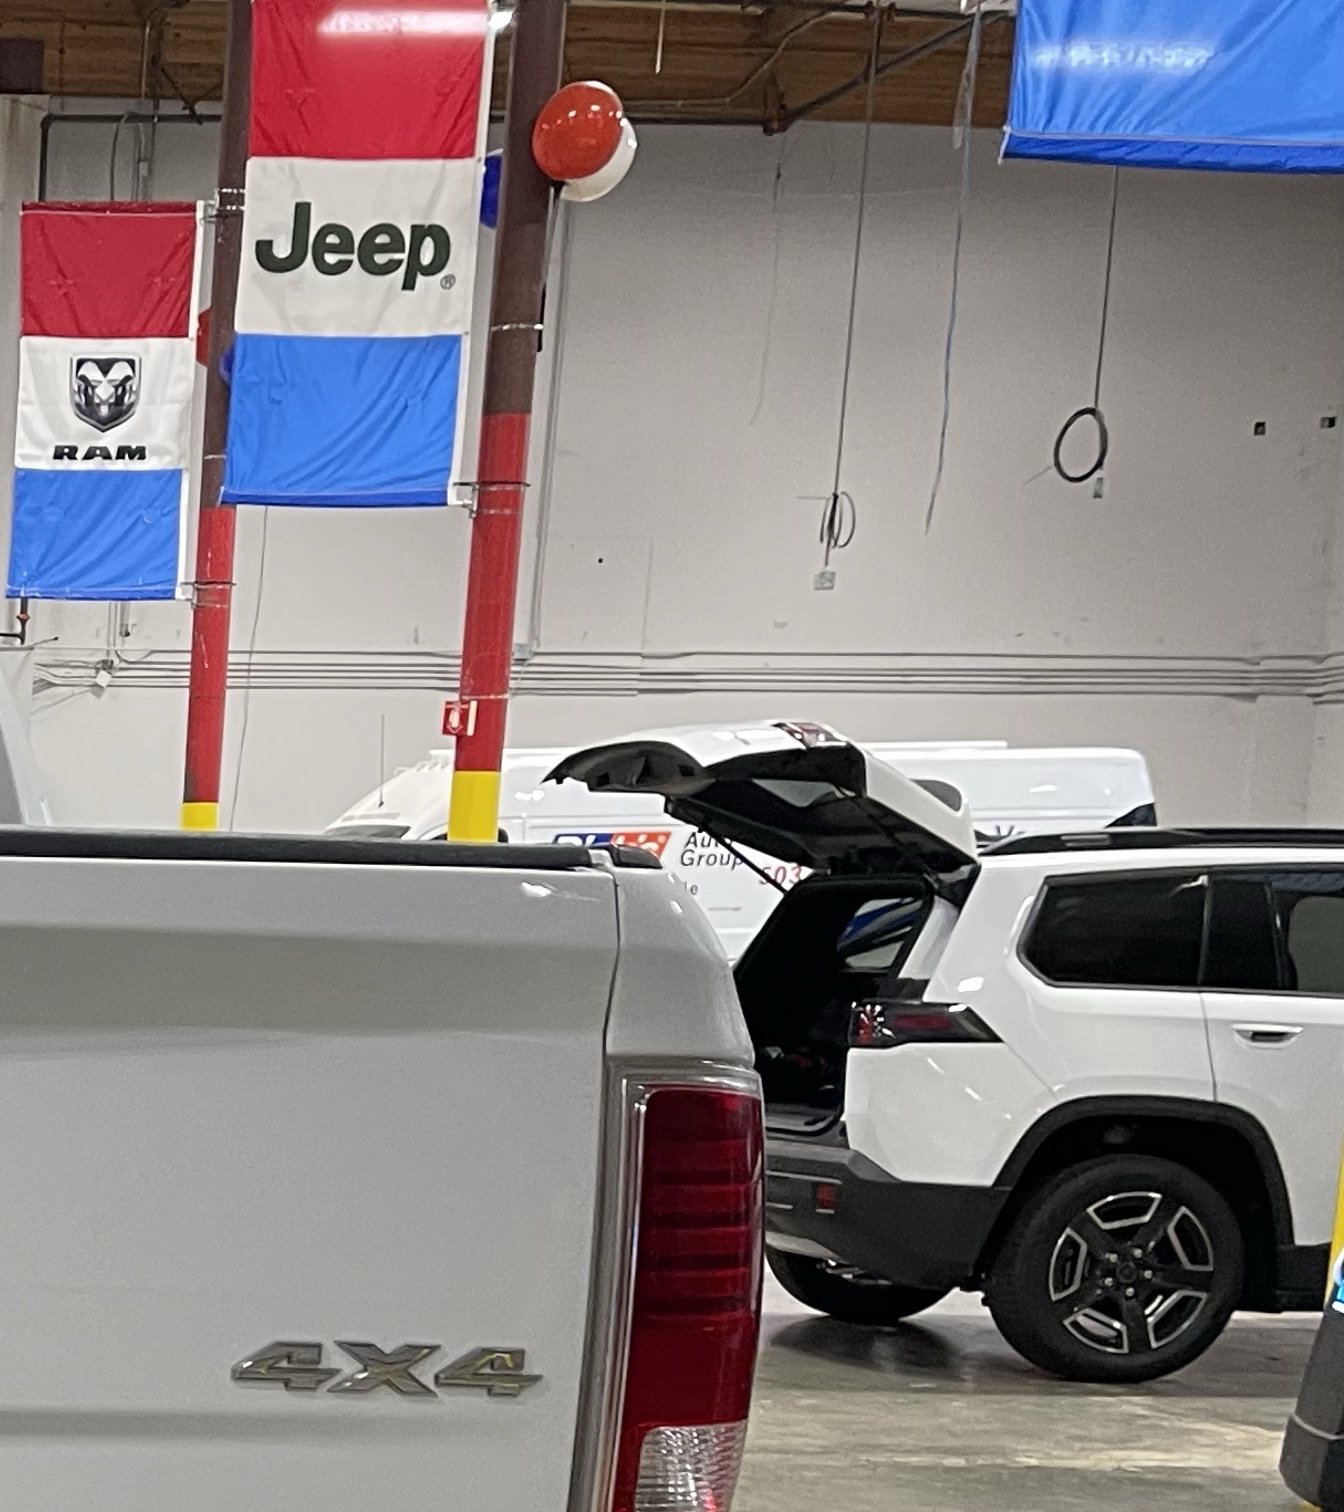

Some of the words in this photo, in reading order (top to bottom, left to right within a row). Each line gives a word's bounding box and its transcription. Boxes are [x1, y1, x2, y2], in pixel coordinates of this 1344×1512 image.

[255, 202, 451, 291] Jeep
[53, 445, 146, 461] RAM
[680, 849, 743, 870] Group
